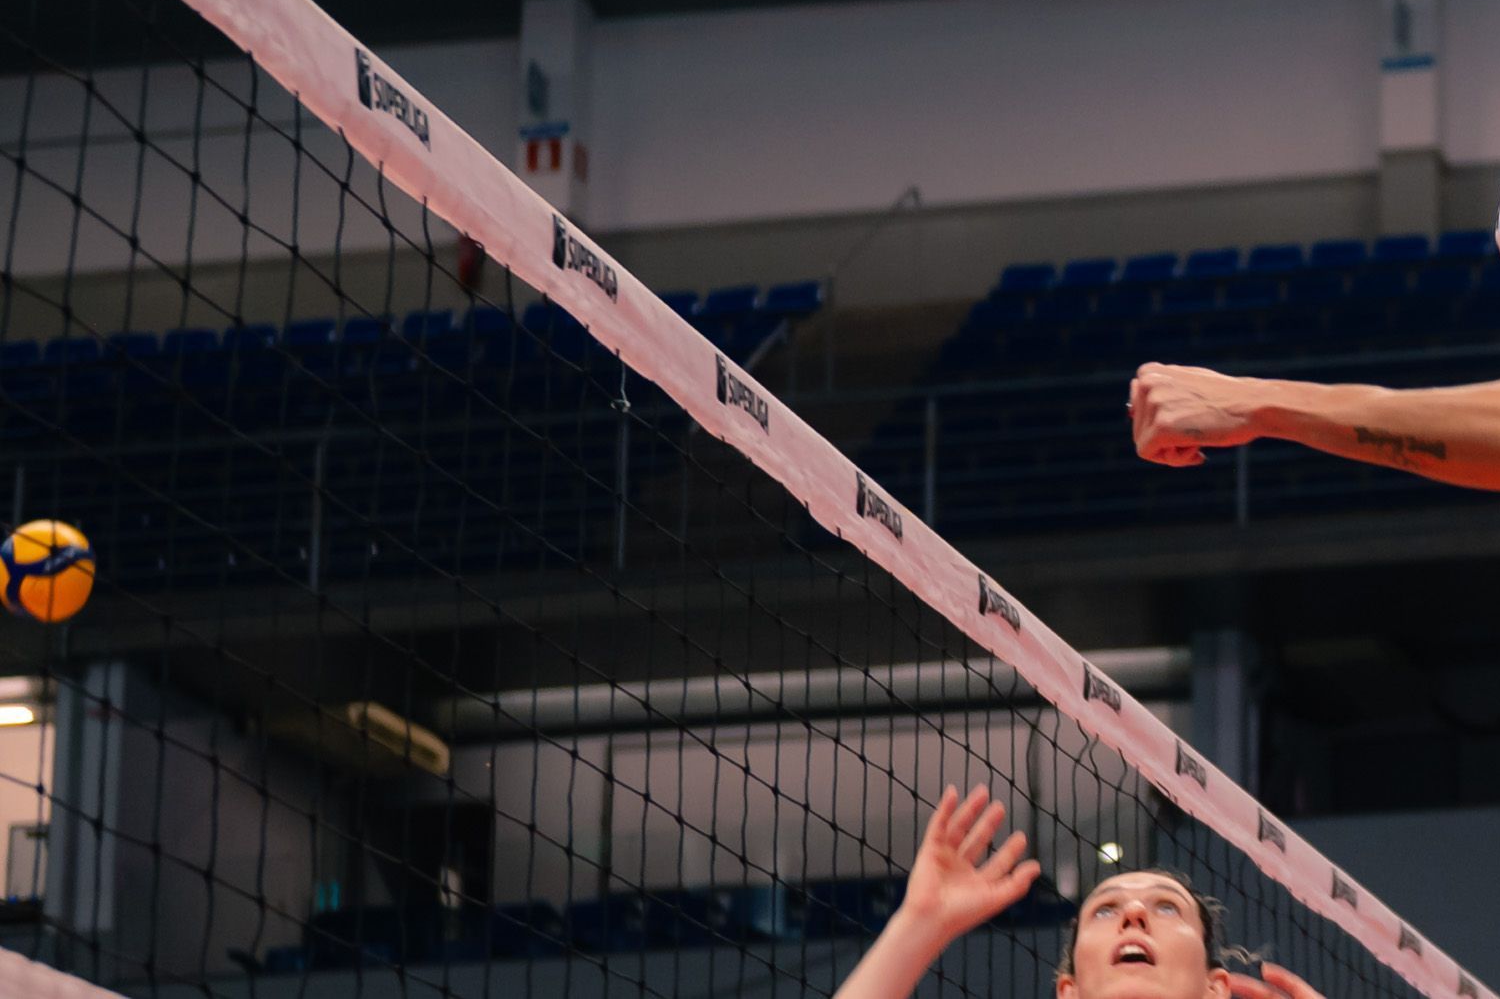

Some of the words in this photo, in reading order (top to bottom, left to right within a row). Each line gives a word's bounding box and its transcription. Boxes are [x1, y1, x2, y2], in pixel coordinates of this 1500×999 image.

[373, 73, 431, 152] SUPERLIGA
[568, 236, 618, 304] SUPERLIGA
[728, 373, 769, 436] SUPERLIGA
